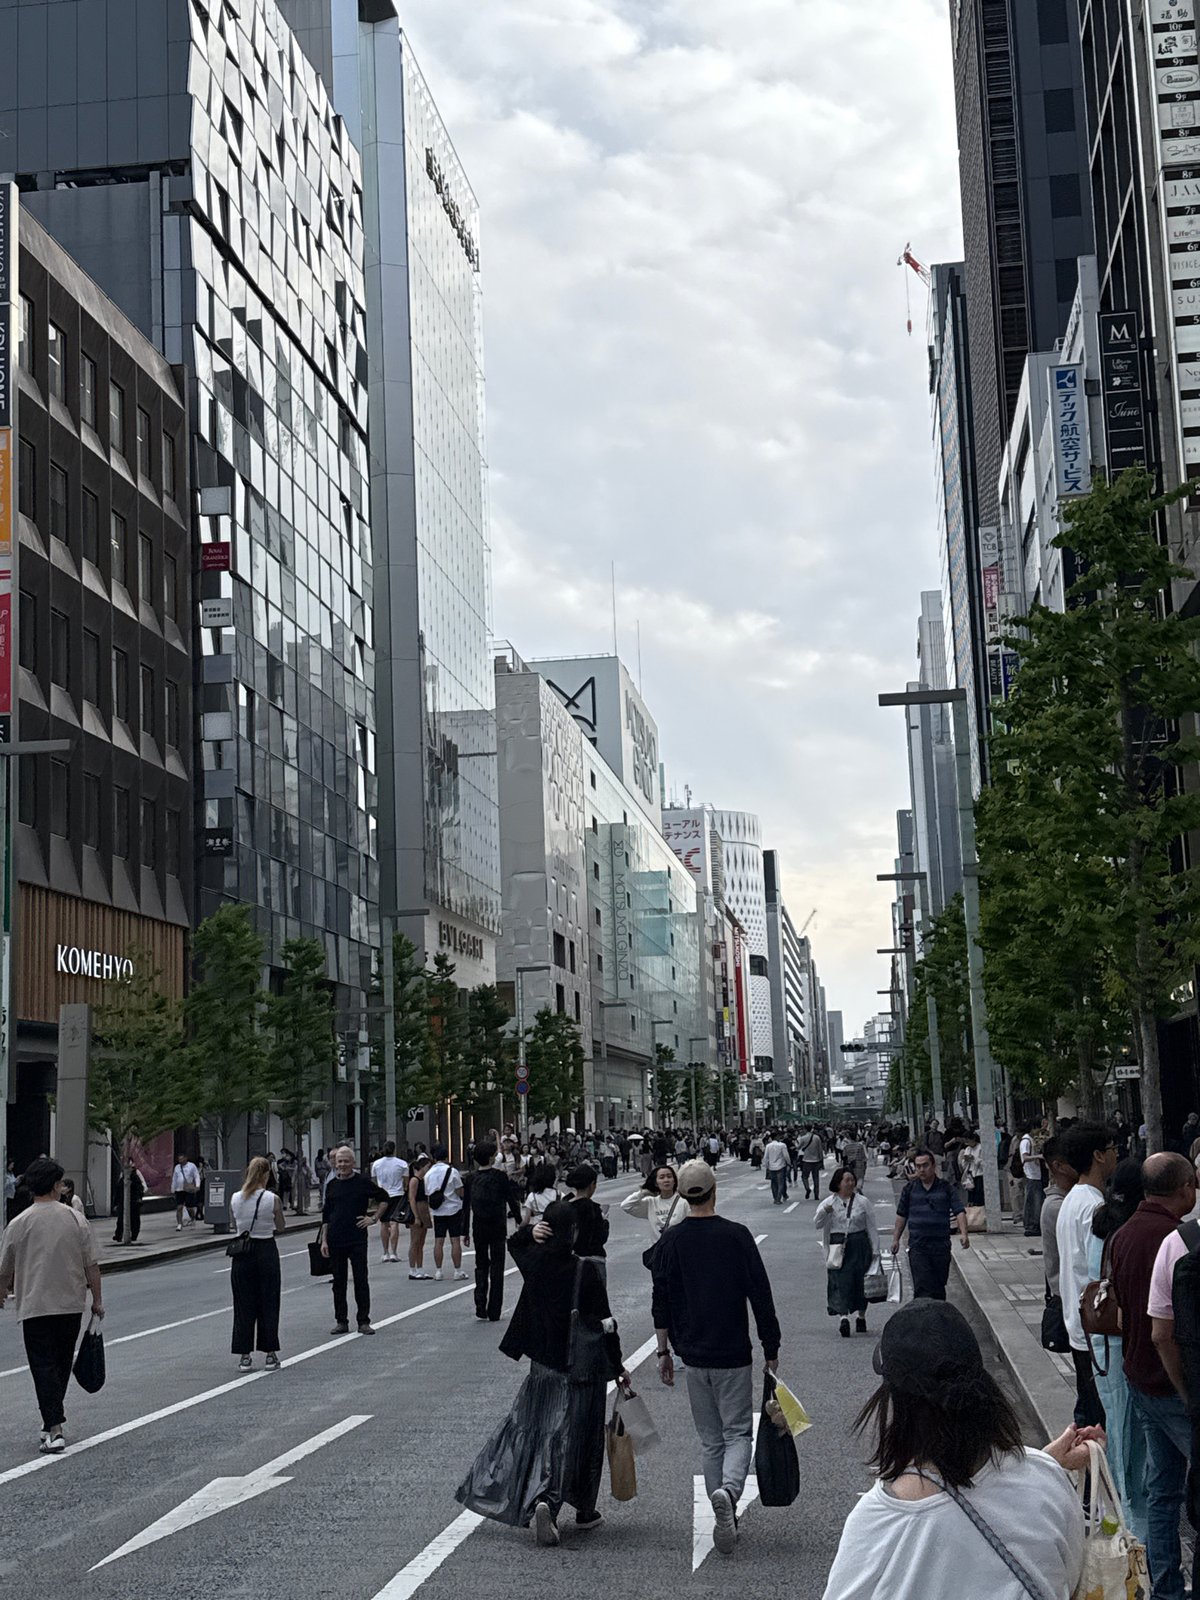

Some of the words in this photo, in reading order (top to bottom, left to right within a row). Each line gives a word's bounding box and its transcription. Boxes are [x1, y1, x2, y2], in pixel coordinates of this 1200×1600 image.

[1172, 57, 1184, 66] 9F
[1175, 93, 1187, 102] 9F
[1182, 170, 1193, 179] 8F
[1184, 206, 1196, 215] 7F
[1187, 243, 1199, 252] 6F
[1058, 391, 1082, 493] テック航空サービス
[664, 830, 701, 841] テナンス
[438, 920, 484, 961] BVLGARI
[57, 943, 134, 984] KOMEHYO
[617, 939, 629, 981] GINZA
